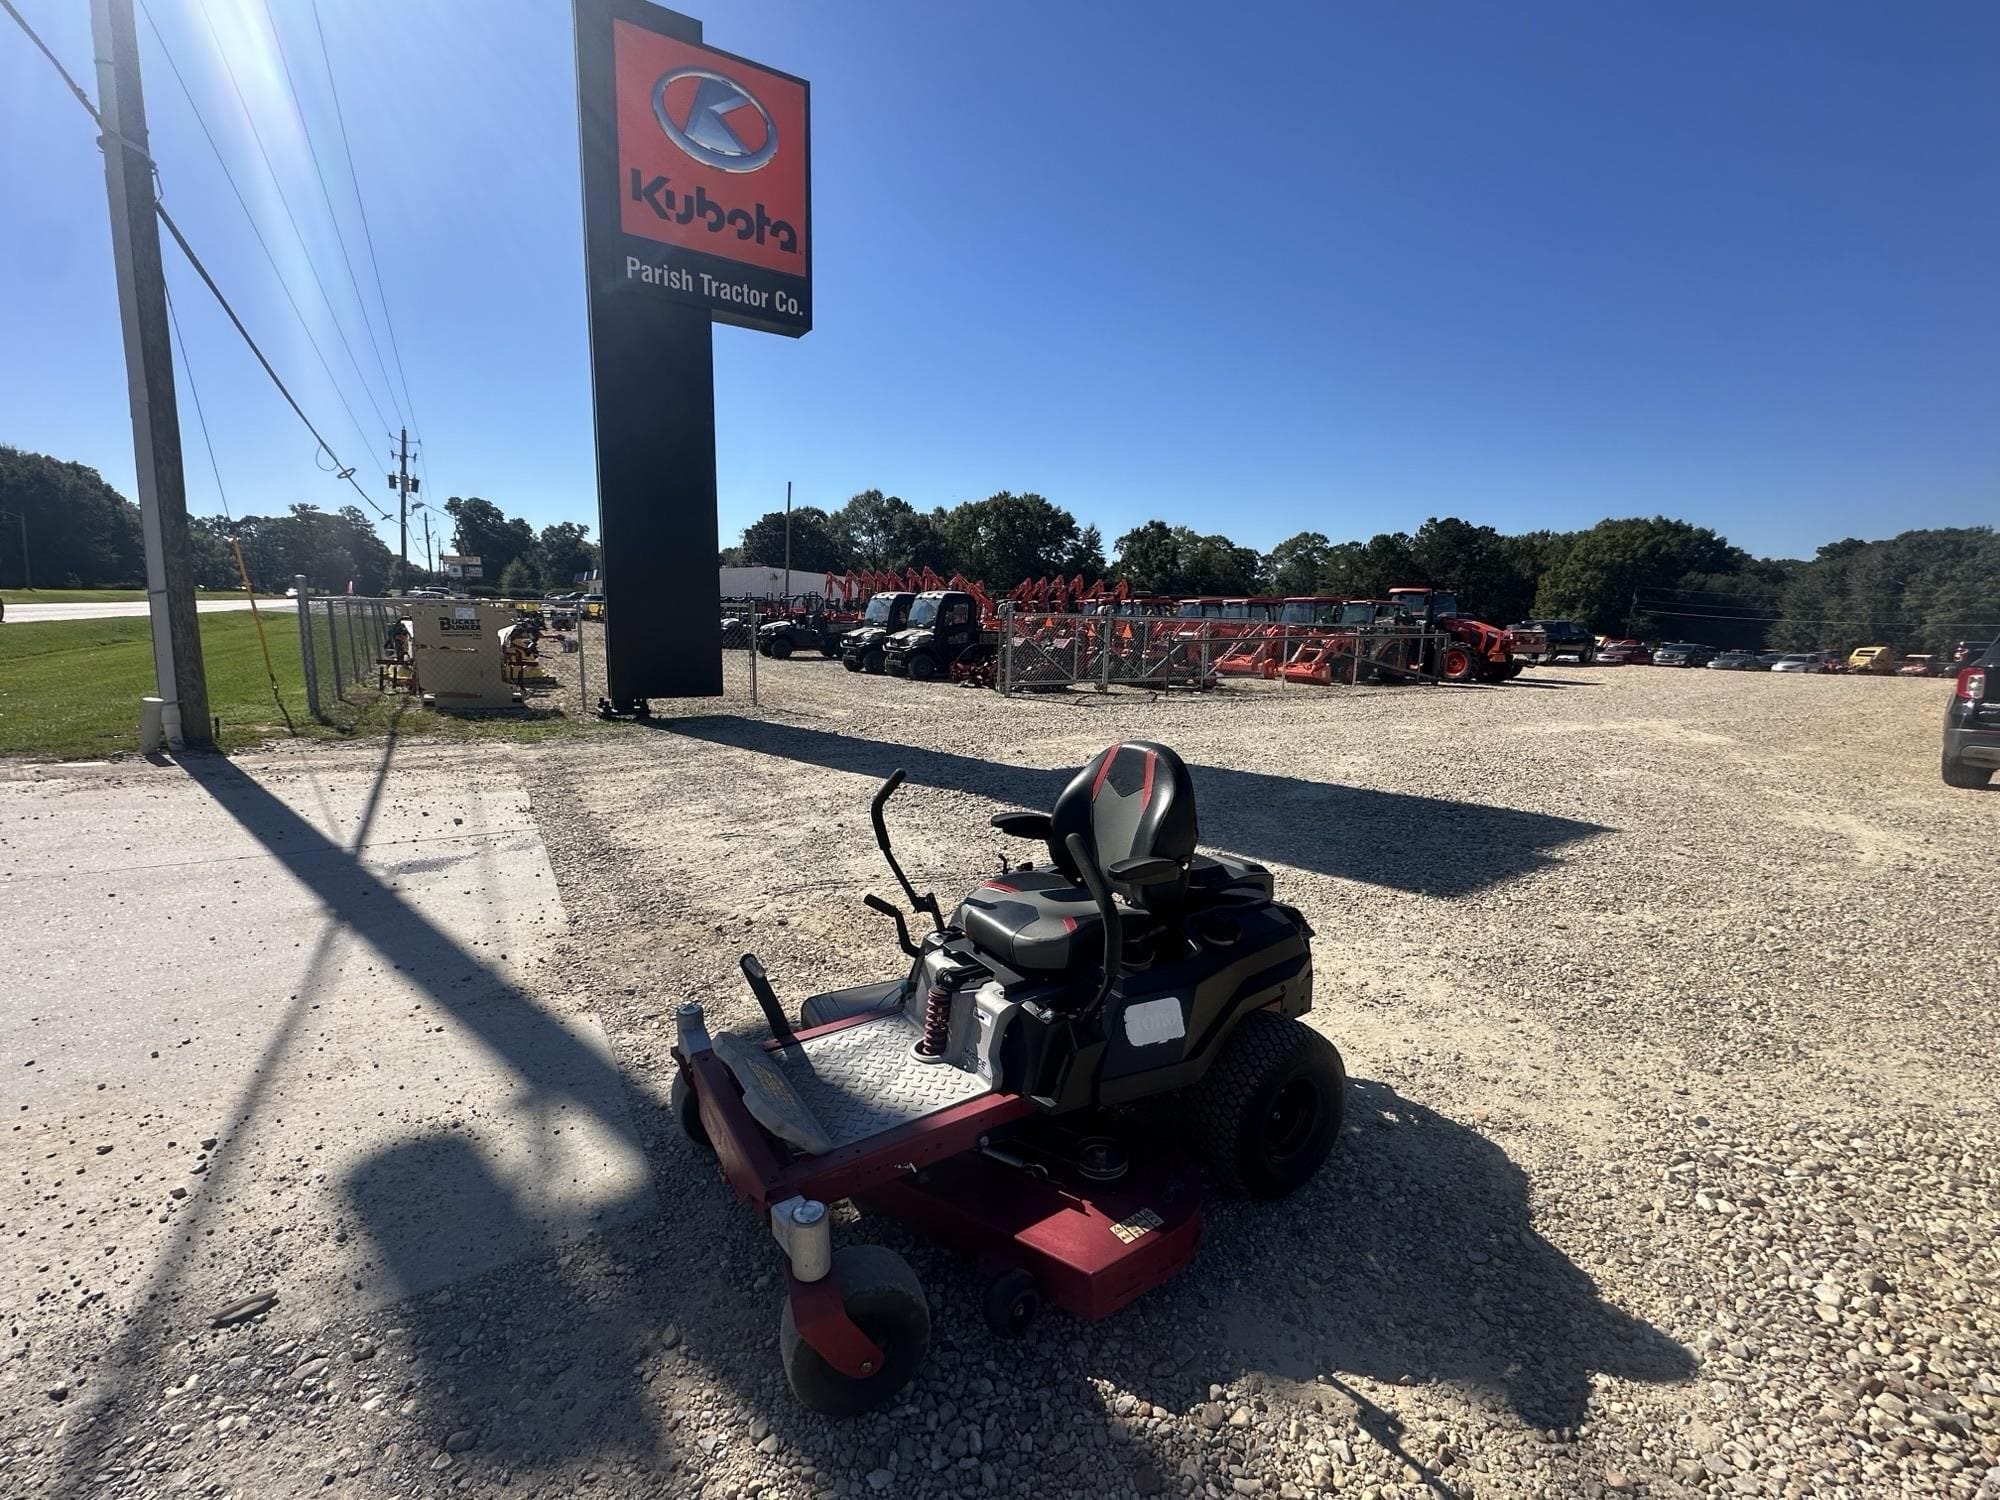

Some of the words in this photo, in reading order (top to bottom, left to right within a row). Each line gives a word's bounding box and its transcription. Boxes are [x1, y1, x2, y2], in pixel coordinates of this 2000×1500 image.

[631, 168, 797, 254] Kubota
[626, 256, 693, 292] Parish
[700, 273, 768, 308] Tractor
[775, 291, 803, 316] Co.
